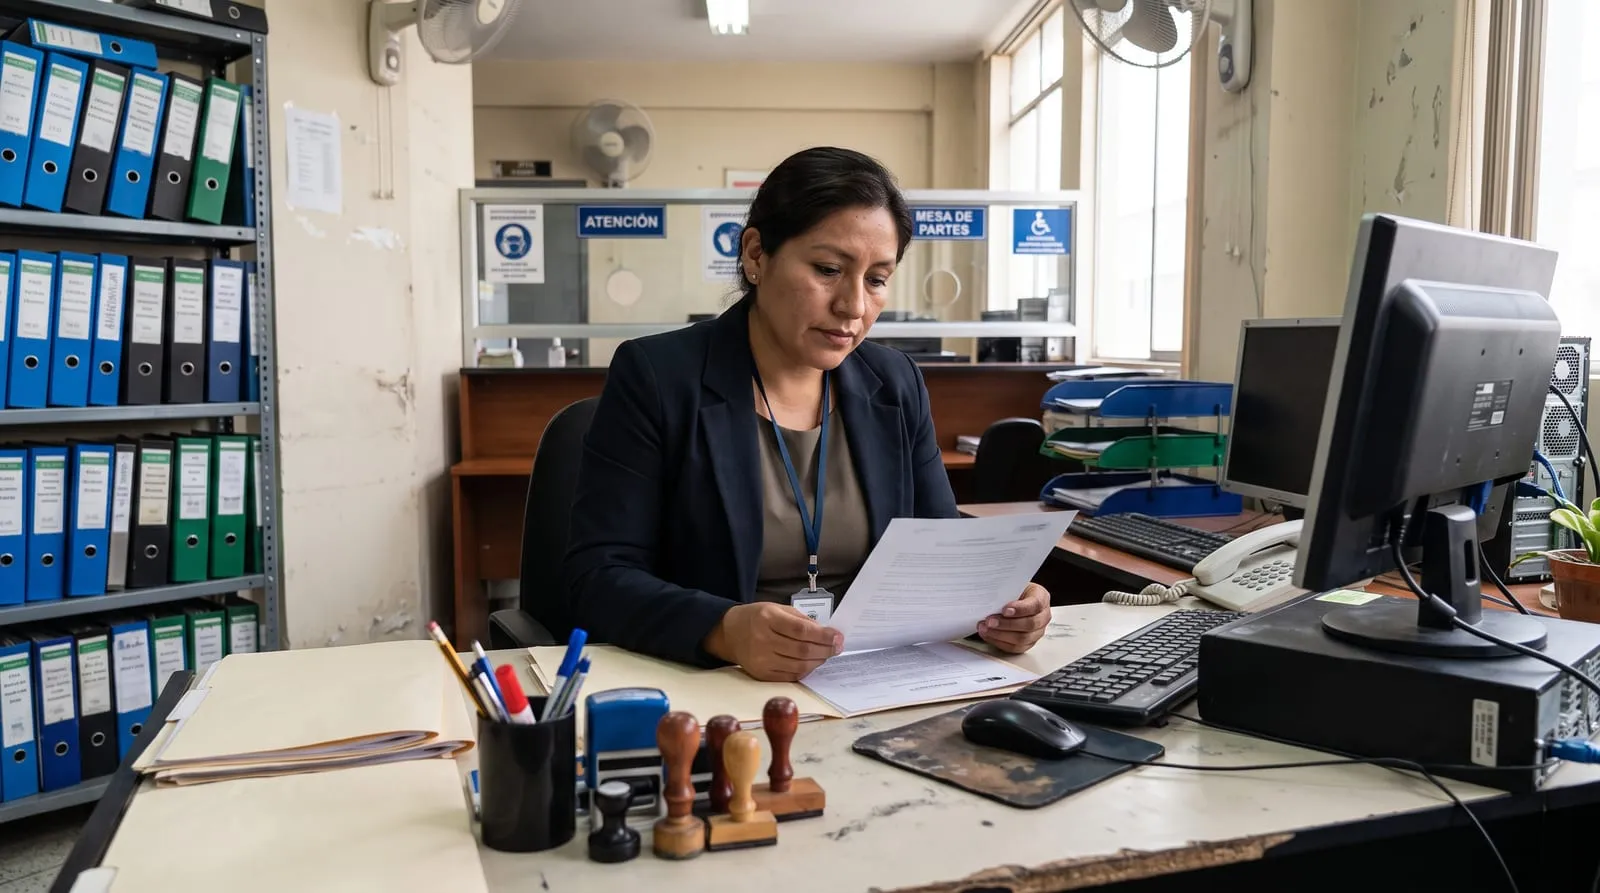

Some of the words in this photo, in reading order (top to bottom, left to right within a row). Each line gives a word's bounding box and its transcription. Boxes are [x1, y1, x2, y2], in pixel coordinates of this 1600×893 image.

[585, 213, 658, 228] ATENCIÓN
[916, 211, 952, 222] MESA
[955, 211, 973, 222] DE
[919, 224, 970, 235] PARTES
